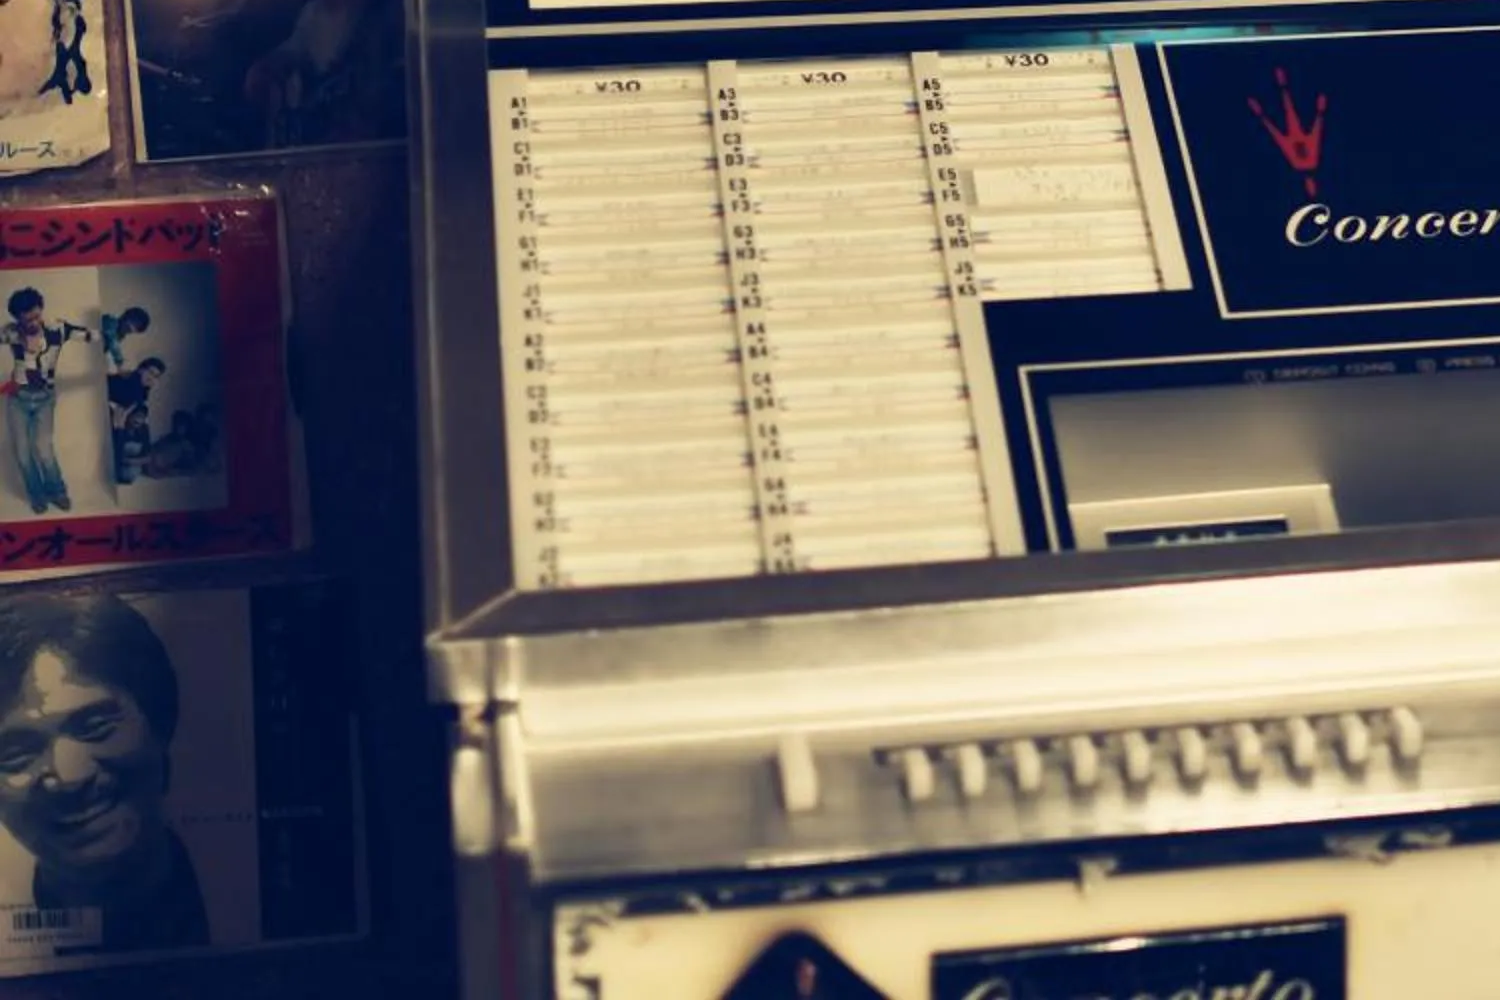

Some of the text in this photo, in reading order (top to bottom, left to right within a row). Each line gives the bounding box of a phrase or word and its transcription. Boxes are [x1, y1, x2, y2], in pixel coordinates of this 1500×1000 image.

[924, 79, 940, 90] A5
[925, 99, 943, 111] B5
[930, 122, 948, 134] C5
[933, 144, 952, 155] D5
[938, 168, 956, 180] E5
[942, 190, 960, 202] F5
[946, 214, 964, 227] G5
[950, 237, 969, 248] H5
[955, 262, 972, 274] J5
[958, 284, 976, 296] K5
